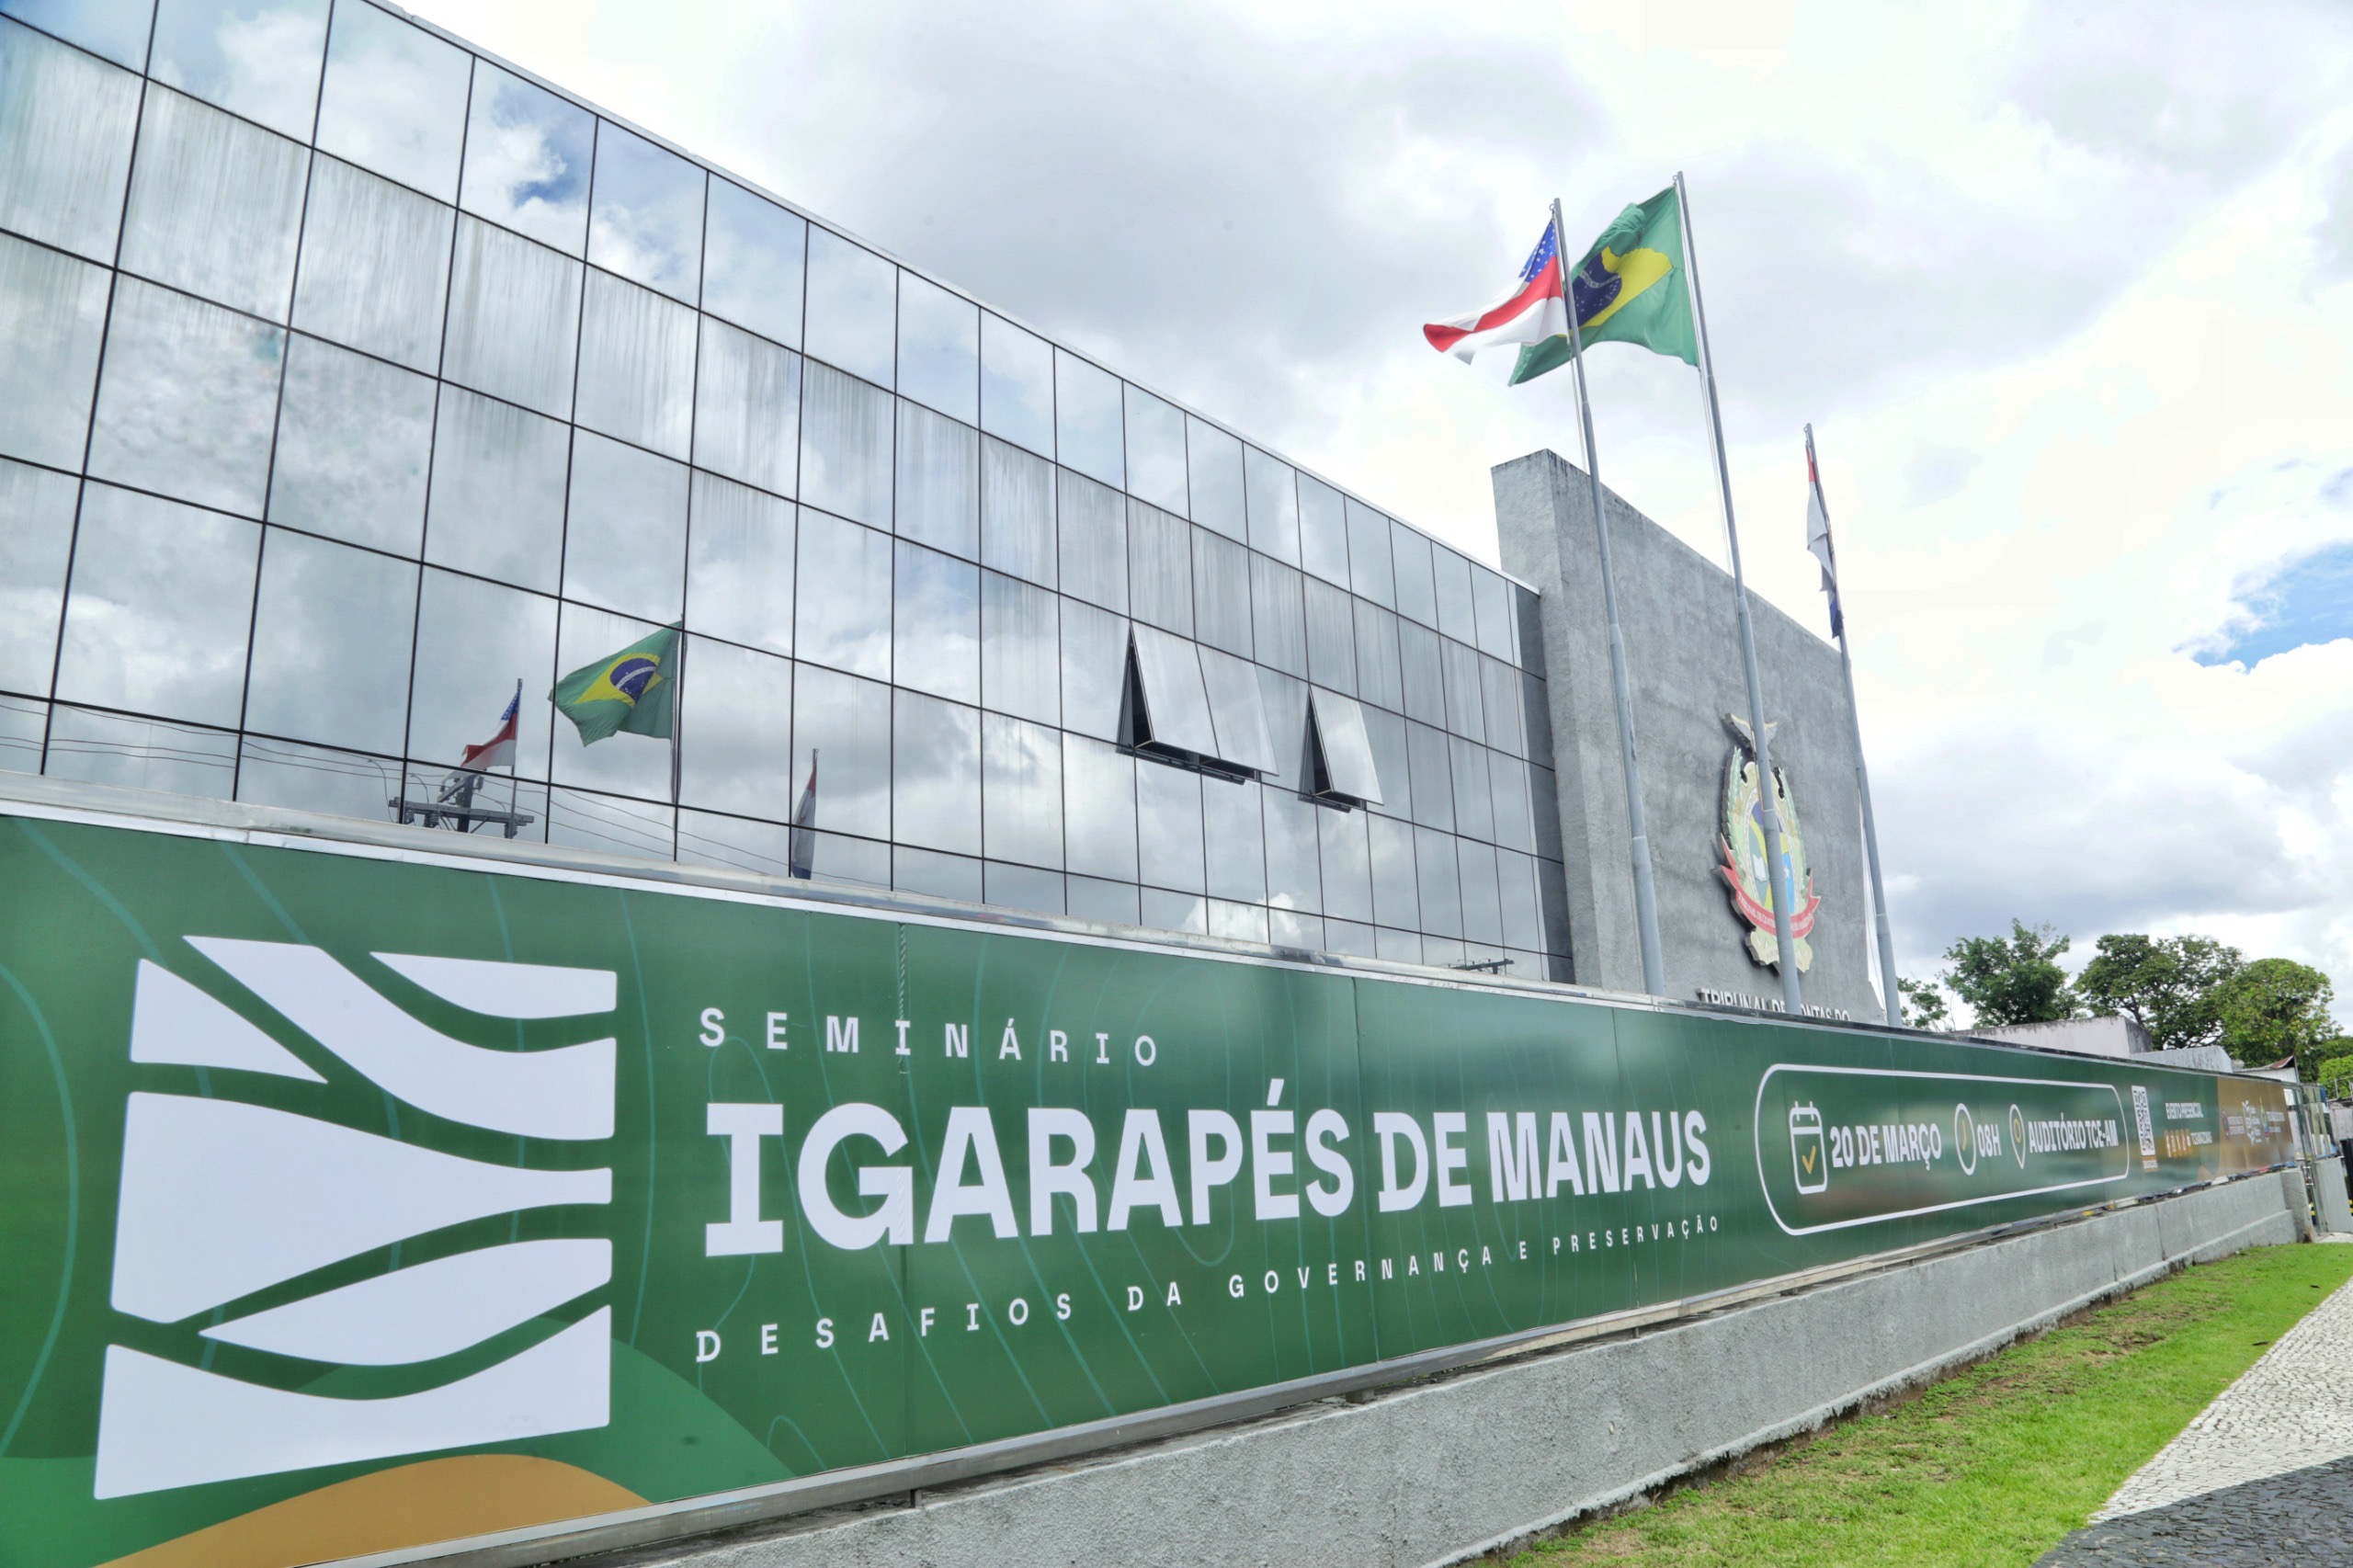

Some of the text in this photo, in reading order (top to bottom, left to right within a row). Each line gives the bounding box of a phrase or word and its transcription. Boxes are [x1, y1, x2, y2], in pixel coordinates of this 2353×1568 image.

[699, 1007, 1156, 1066] SEMINÁRIO
[1830, 1123, 1941, 1170] 20 DE MARÇO
[1977, 1124, 2002, 1156] 08H
[2029, 1113, 2119, 1153] AUDITÓRIO TCE-AM
[706, 1078, 1710, 1256] IGARAPÉS DE MANAUS
[697, 1215, 1717, 1362] DESAFIOS DA GOVERNANÇA E PRESERVAÇÃO
